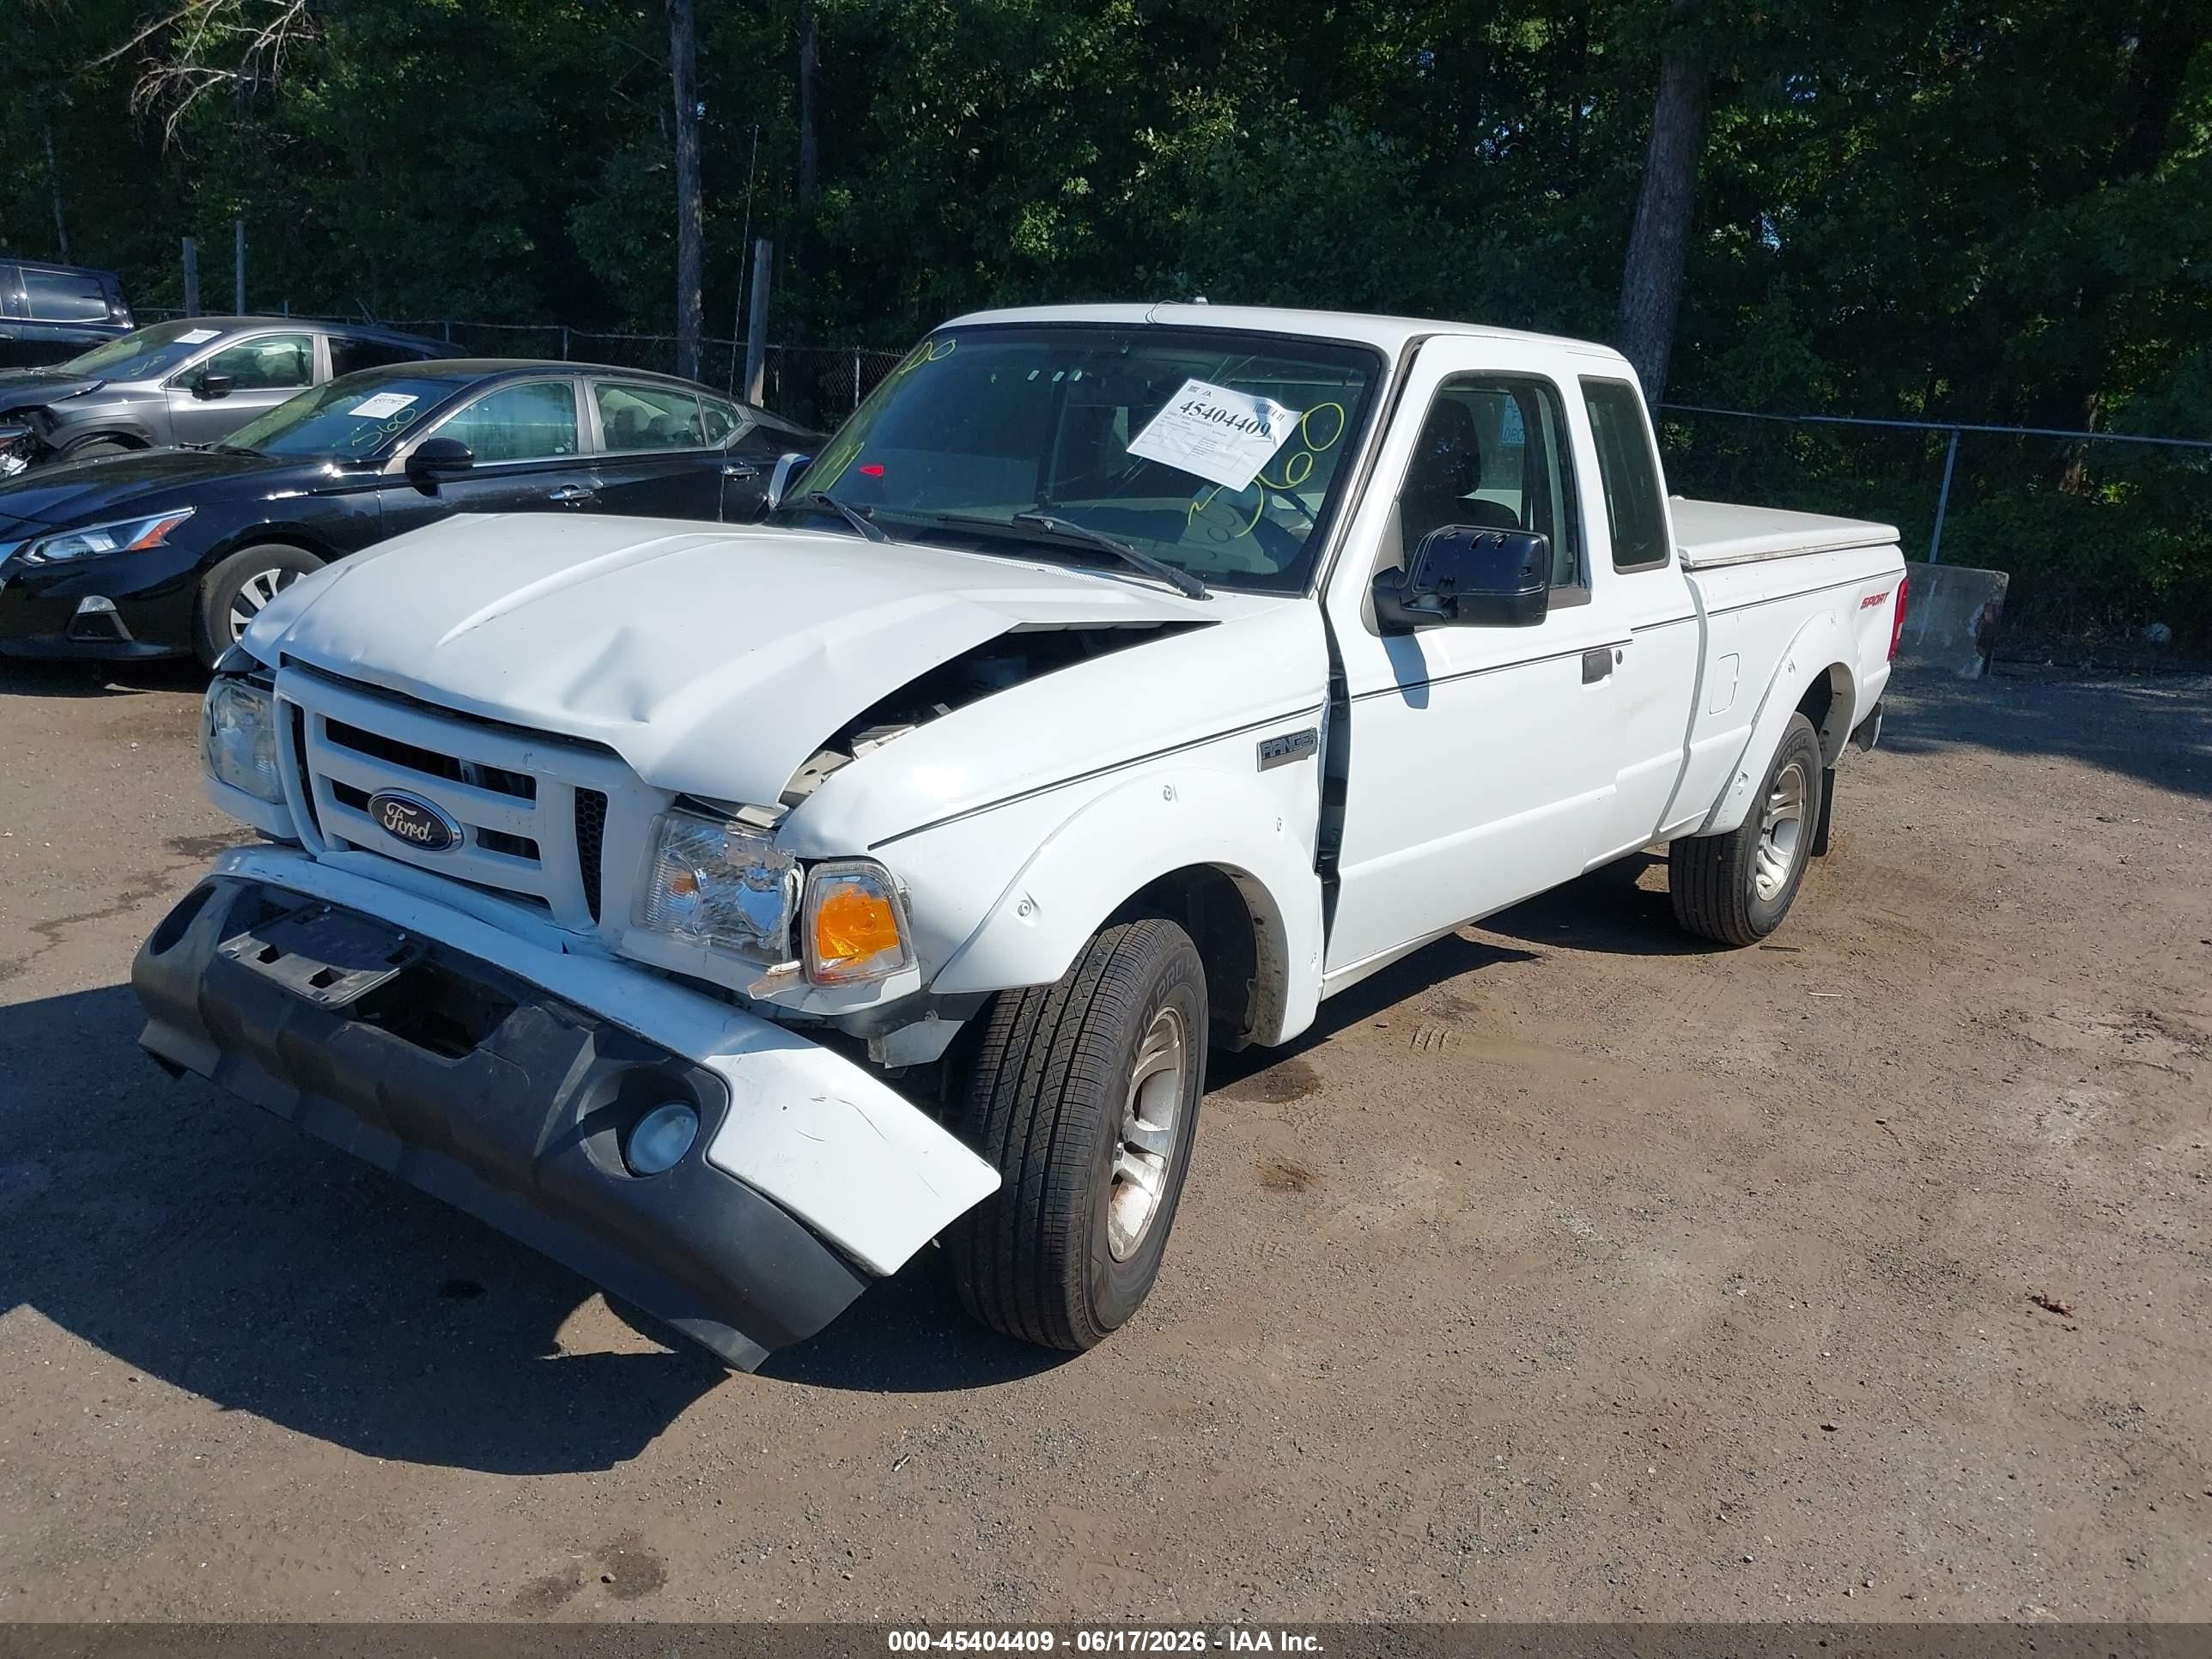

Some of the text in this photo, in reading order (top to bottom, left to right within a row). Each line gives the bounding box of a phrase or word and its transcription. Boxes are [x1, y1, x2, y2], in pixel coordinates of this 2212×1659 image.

[1179, 400, 1272, 438] 45404409
[1860, 591, 1890, 610] SPORT
[1261, 728, 1317, 759] RANGER
[384, 801, 432, 842] Ford
